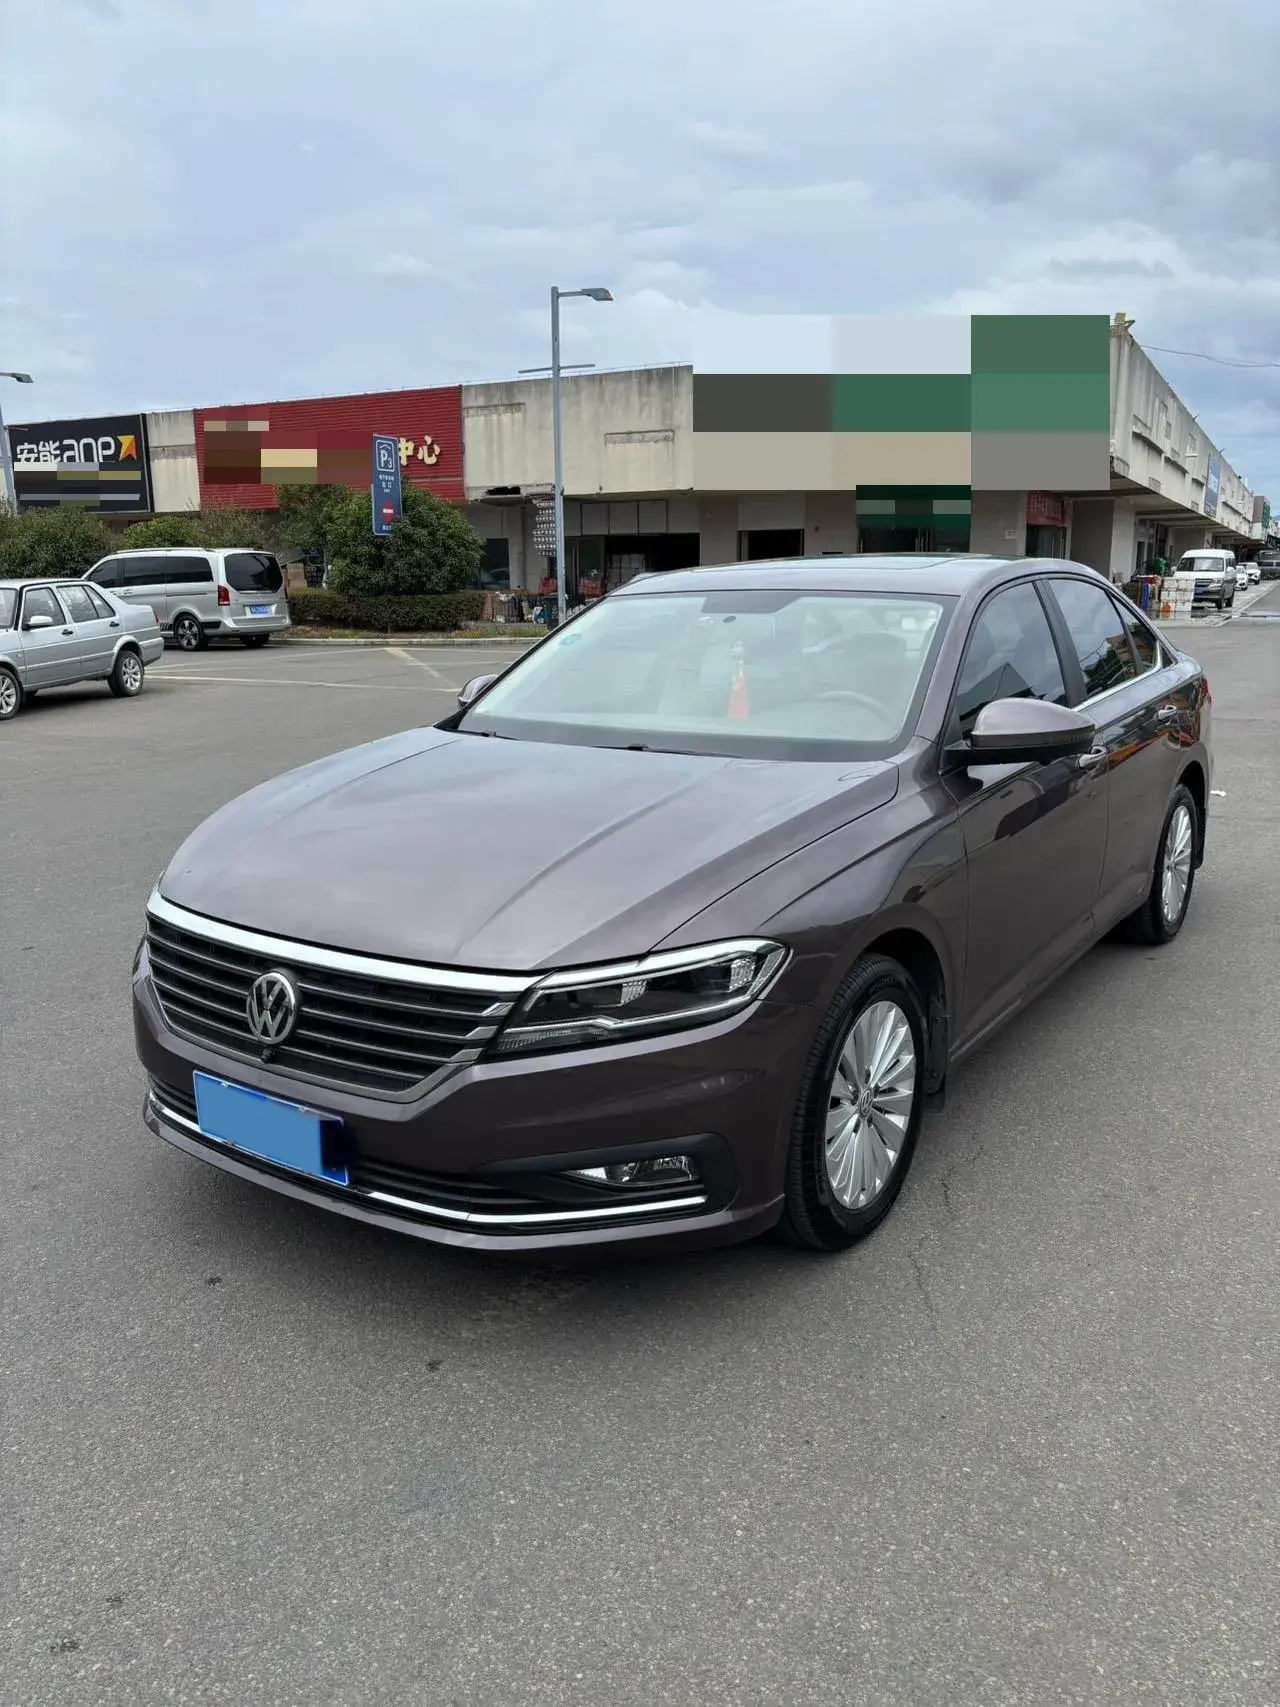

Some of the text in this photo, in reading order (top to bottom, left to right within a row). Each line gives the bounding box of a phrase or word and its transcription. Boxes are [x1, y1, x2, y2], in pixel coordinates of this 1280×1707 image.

[16, 440, 61, 462] 安能
[380, 449, 393, 469] P3
[398, 435, 441, 466] 中心
